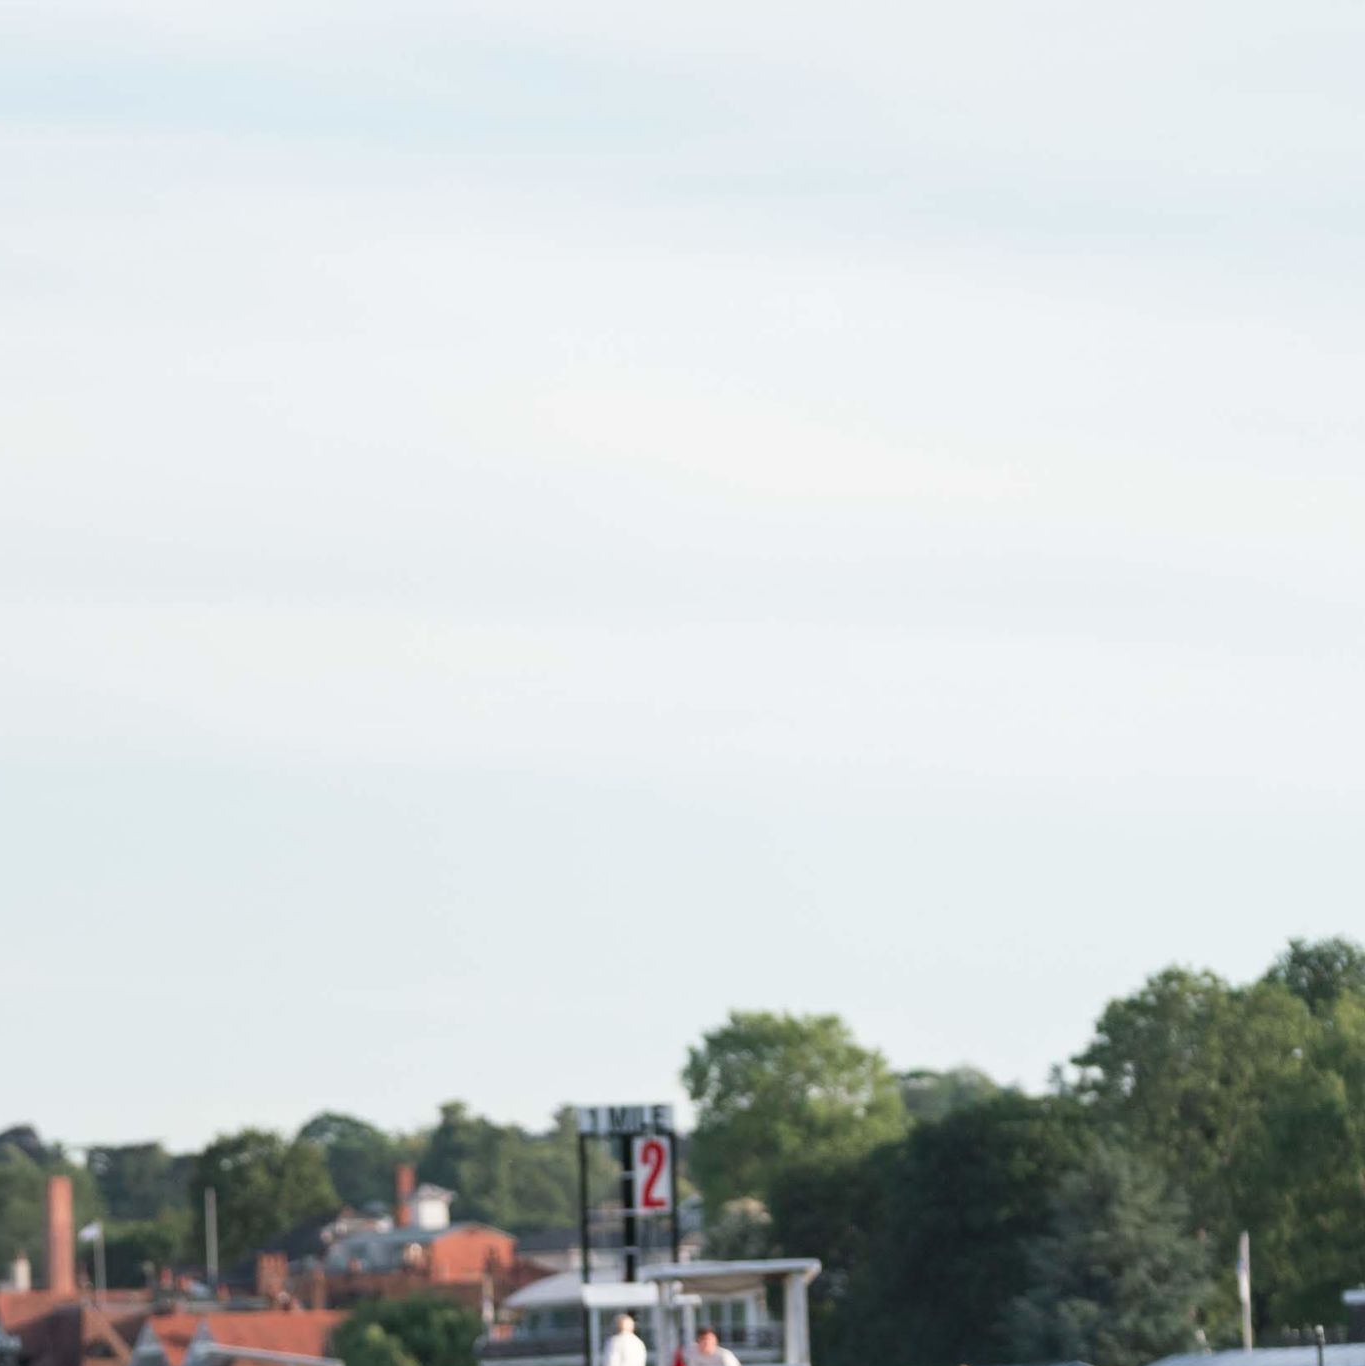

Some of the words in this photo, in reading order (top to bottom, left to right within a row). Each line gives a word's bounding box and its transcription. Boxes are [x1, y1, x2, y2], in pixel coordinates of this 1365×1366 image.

[587, 1107, 599, 1133] 1
[610, 1105, 669, 1134] MILE
[641, 1140, 666, 1209] 2
